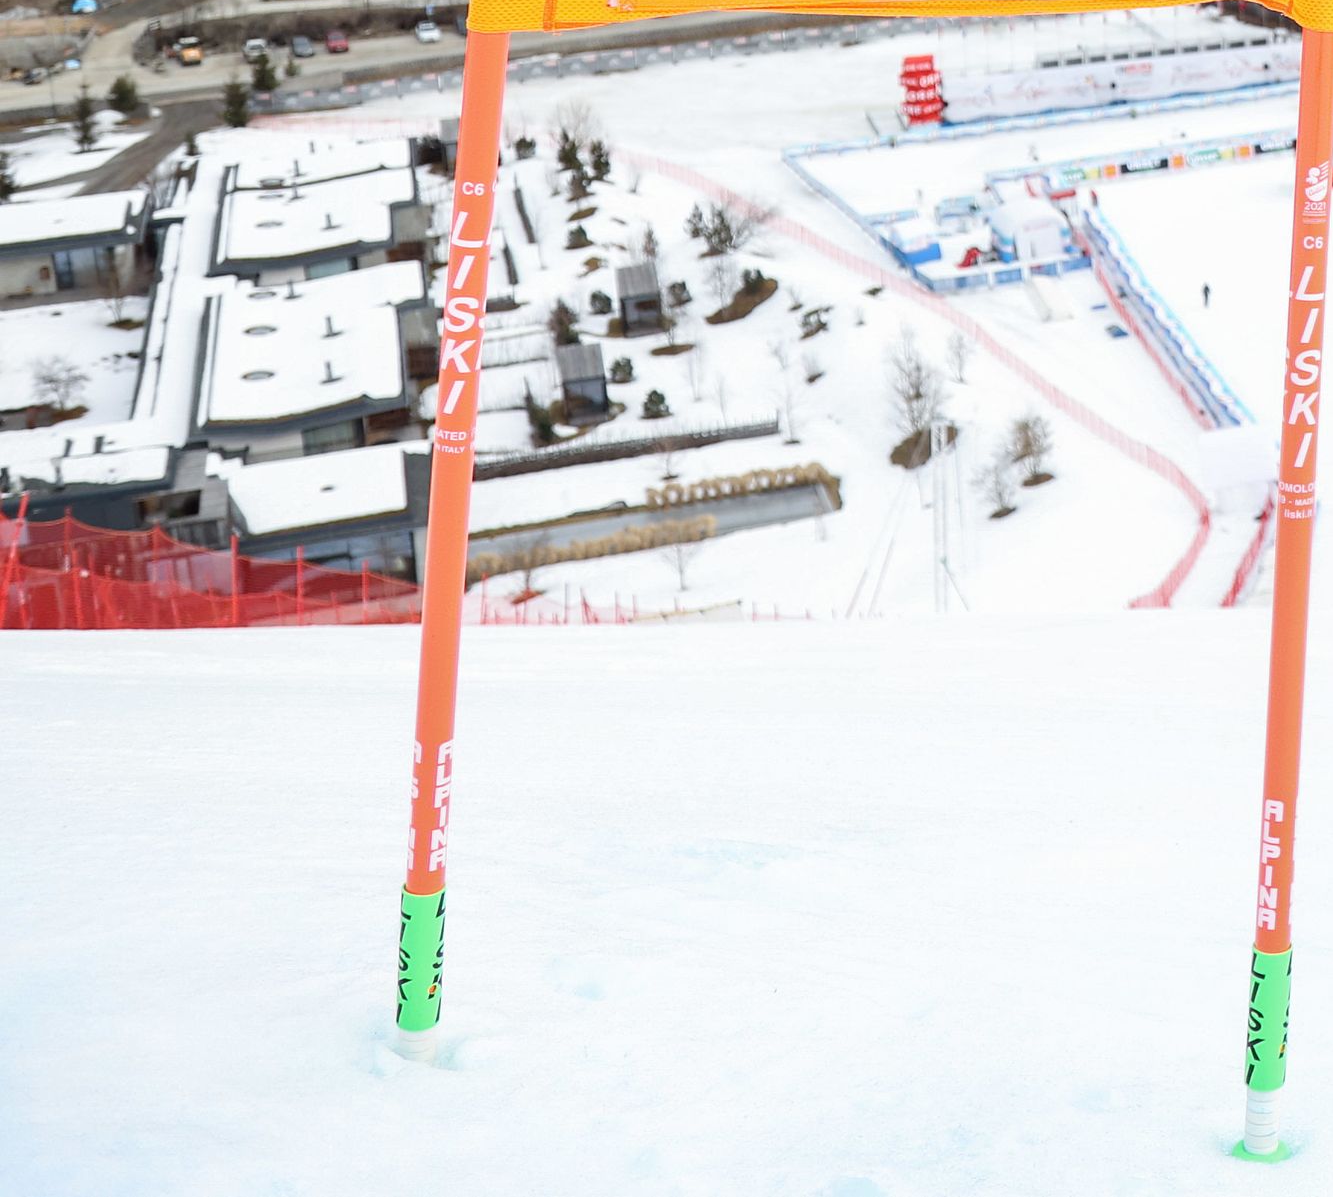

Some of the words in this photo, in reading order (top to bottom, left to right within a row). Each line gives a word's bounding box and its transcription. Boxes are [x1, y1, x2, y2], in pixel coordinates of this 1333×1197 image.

[462, 182, 485, 196] C6
[1303, 236, 1323, 249] C6
[1304, 202, 1326, 210] 2021
[441, 211, 485, 415] LISKI
[1289, 266, 1324, 468] LISKI
[441, 445, 465, 454] ITALY
[428, 740, 453, 871] ALPINA
[1258, 799, 1284, 931] ALPINA
[1245, 953, 1266, 1085] LISKI
